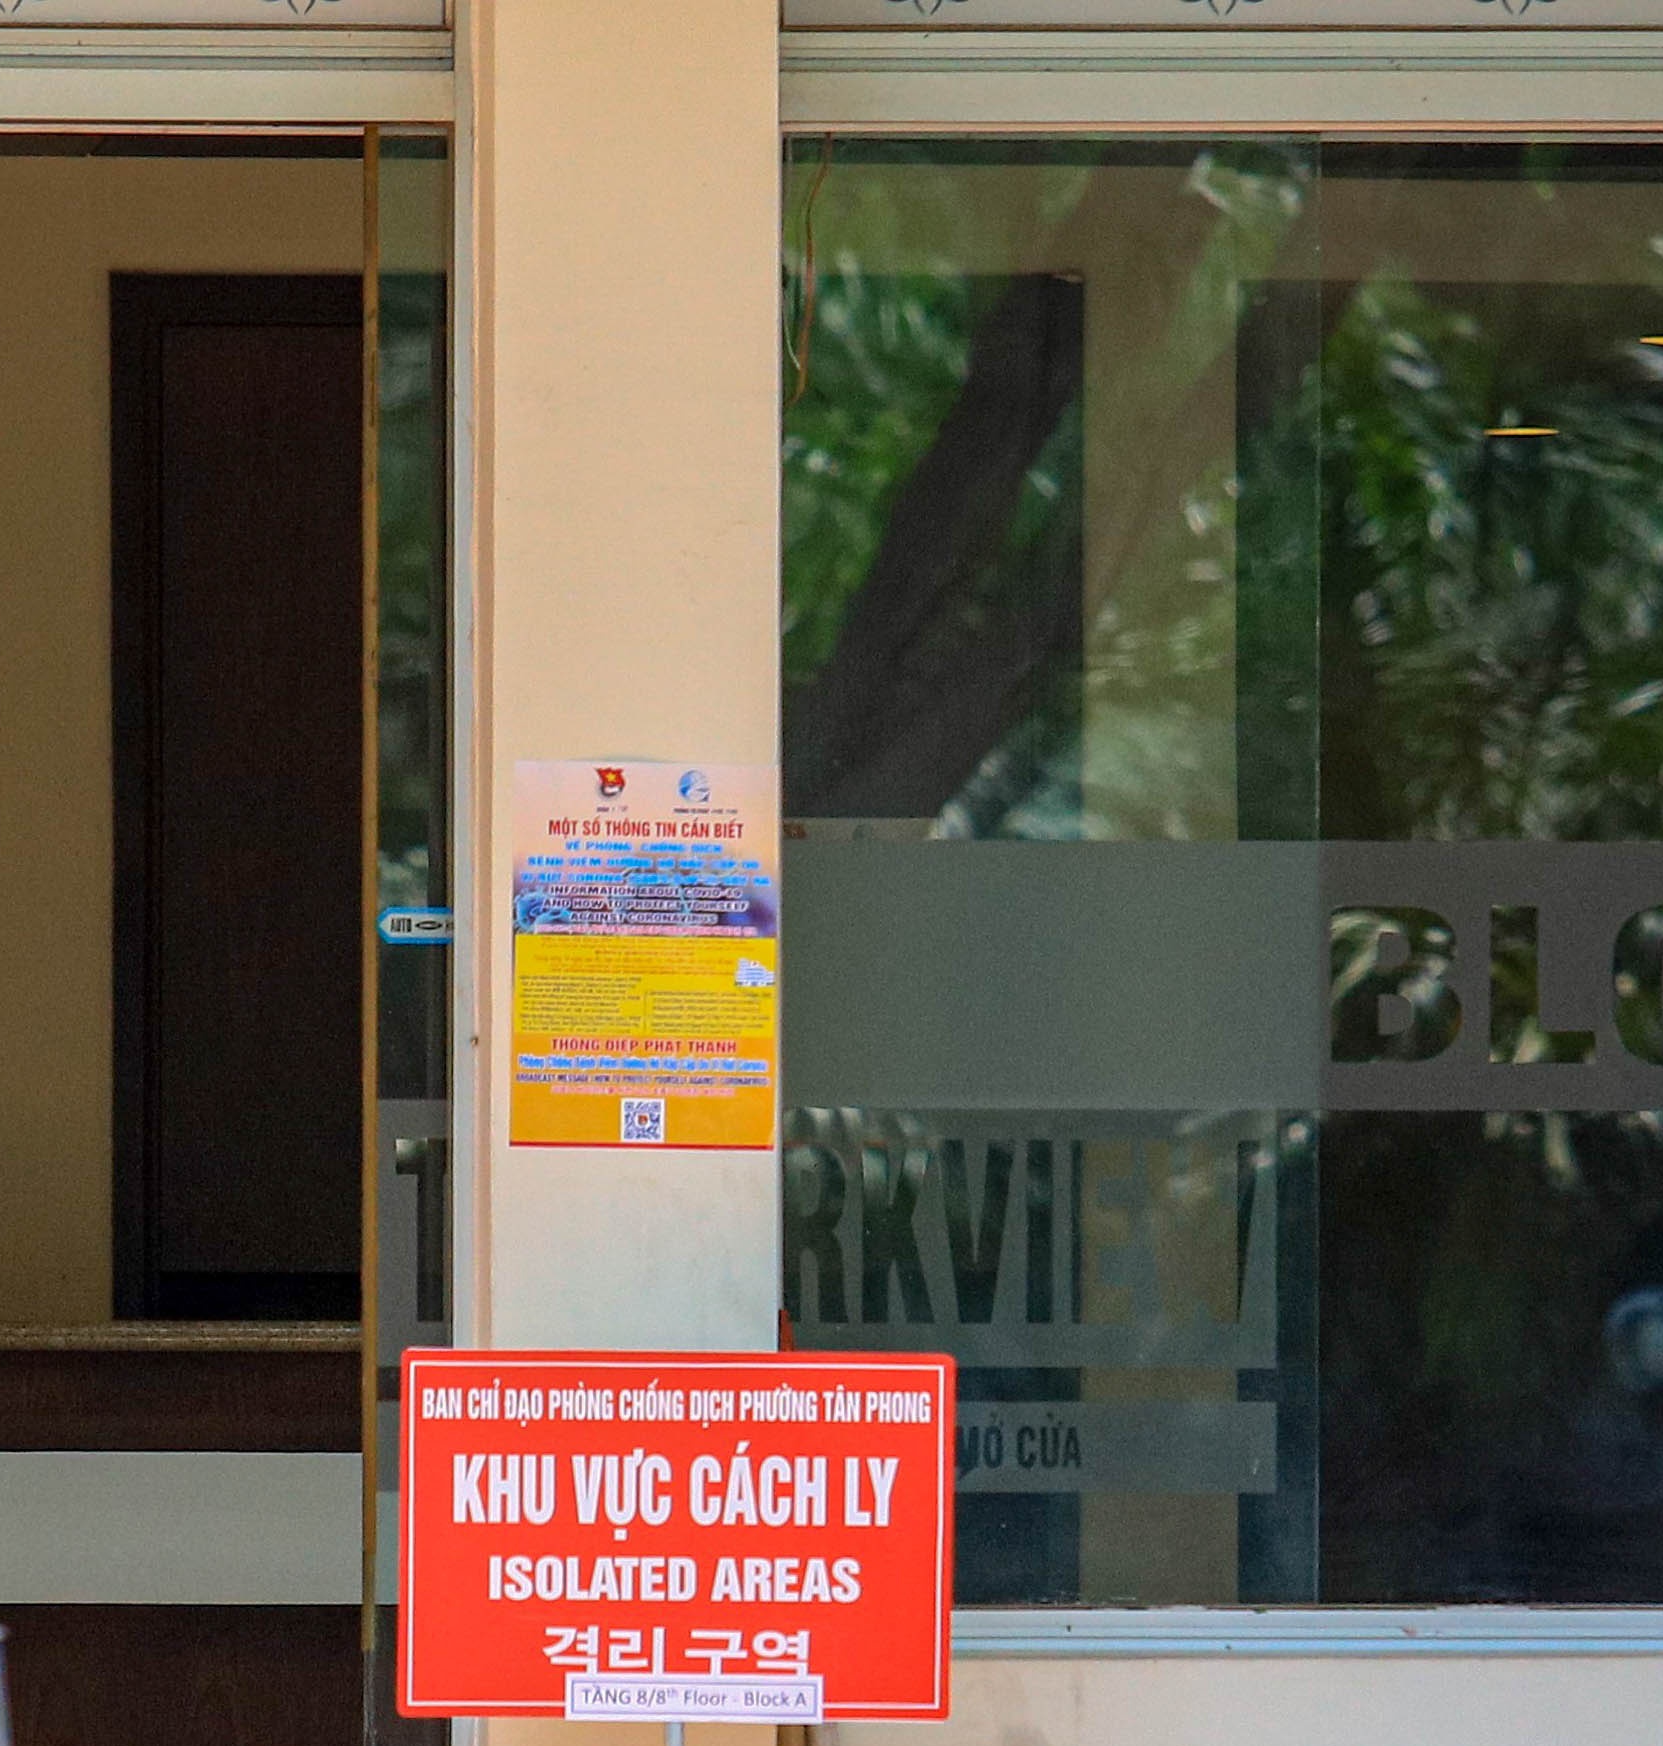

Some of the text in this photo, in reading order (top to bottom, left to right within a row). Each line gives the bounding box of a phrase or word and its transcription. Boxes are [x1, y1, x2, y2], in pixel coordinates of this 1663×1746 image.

[655, 822, 677, 838] TIN
[422, 1378, 932, 1429] BAN CHỈ ĐẠO PHÒNG CHỐNG DỊCH PHƯỜNG TÂN PHONG
[1017, 1412, 1082, 1469] CỬA
[452, 1441, 899, 1541] KHU VỰC CÁCH LY
[488, 1555, 862, 1603] ISOLATED AREAS
[542, 1626, 810, 1675] 격리 구역
[684, 1691, 728, 1706] Floor
[744, 1692, 791, 1708] Block
[795, 1694, 808, 1707] A
